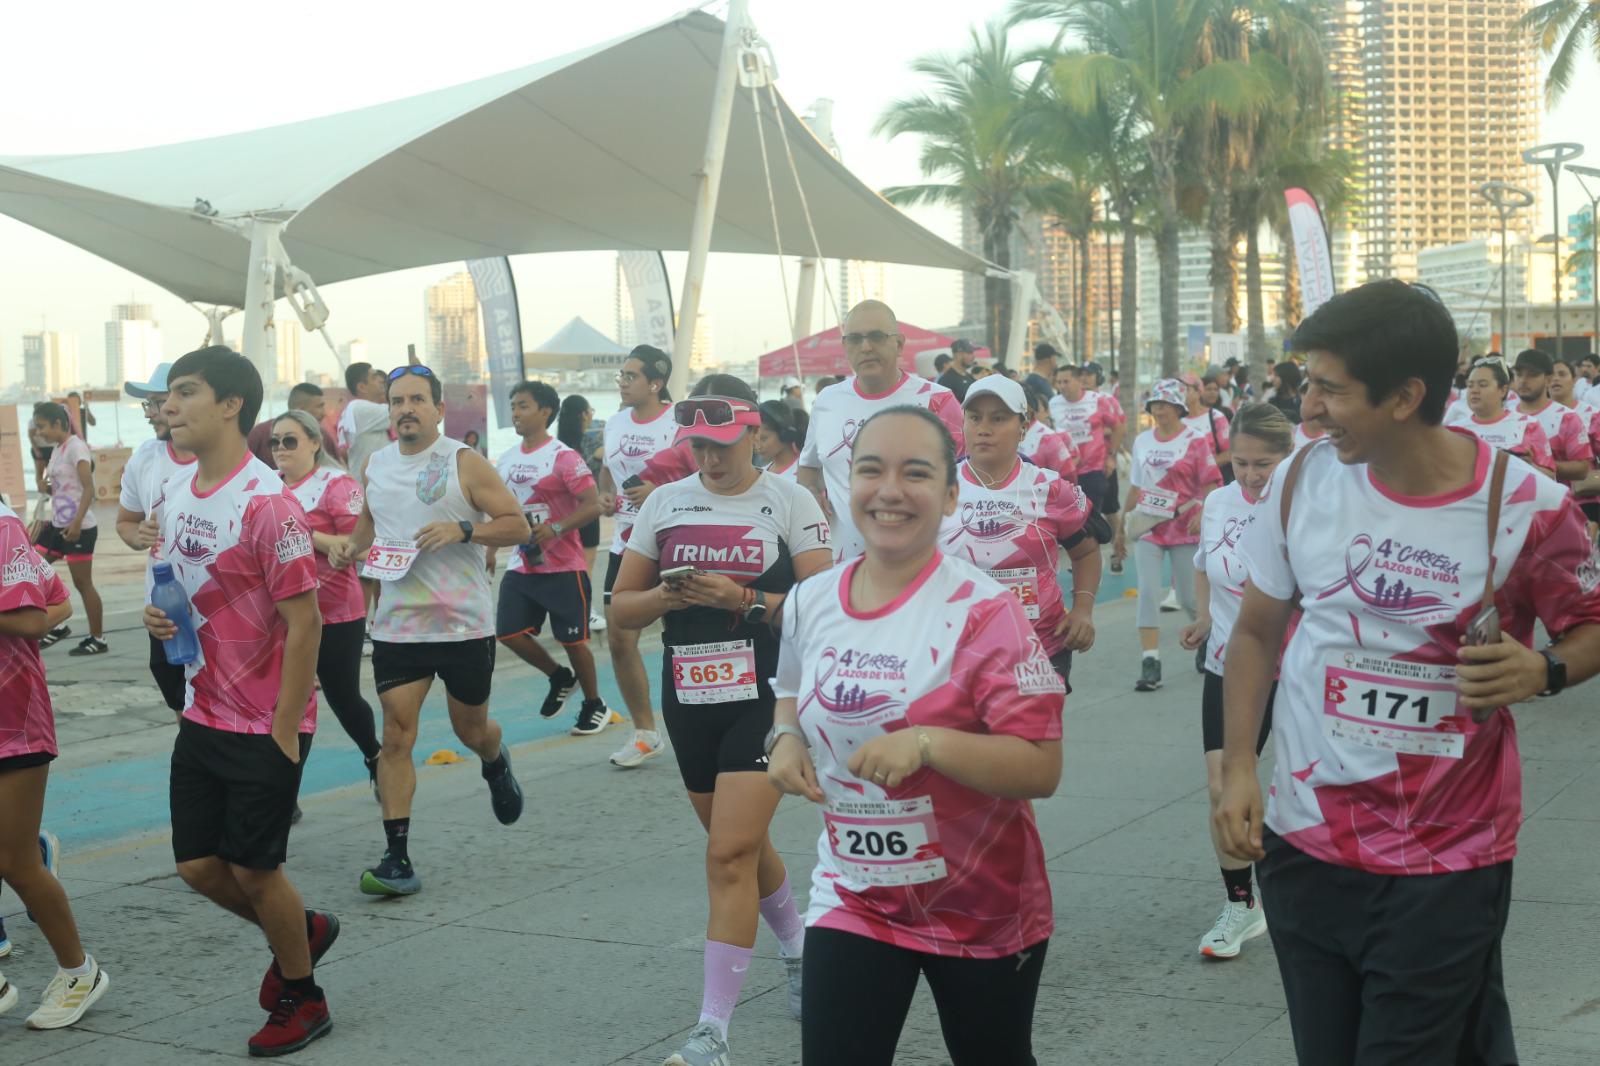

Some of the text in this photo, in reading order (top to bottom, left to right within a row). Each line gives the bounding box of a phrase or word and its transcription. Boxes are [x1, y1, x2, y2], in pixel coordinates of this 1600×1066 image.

[385, 554, 411, 567] 731
[672, 543, 762, 565] TRIMAZ
[1398, 546, 1462, 575] CARRERA
[1375, 559, 1460, 585] LAZOS DE VIDA
[689, 662, 735, 684] 663
[856, 652, 908, 673] CARRERA
[837, 668, 905, 681] LAZOS DE VIDA
[1361, 688, 1430, 723] 171
[846, 830, 908, 856] 206
